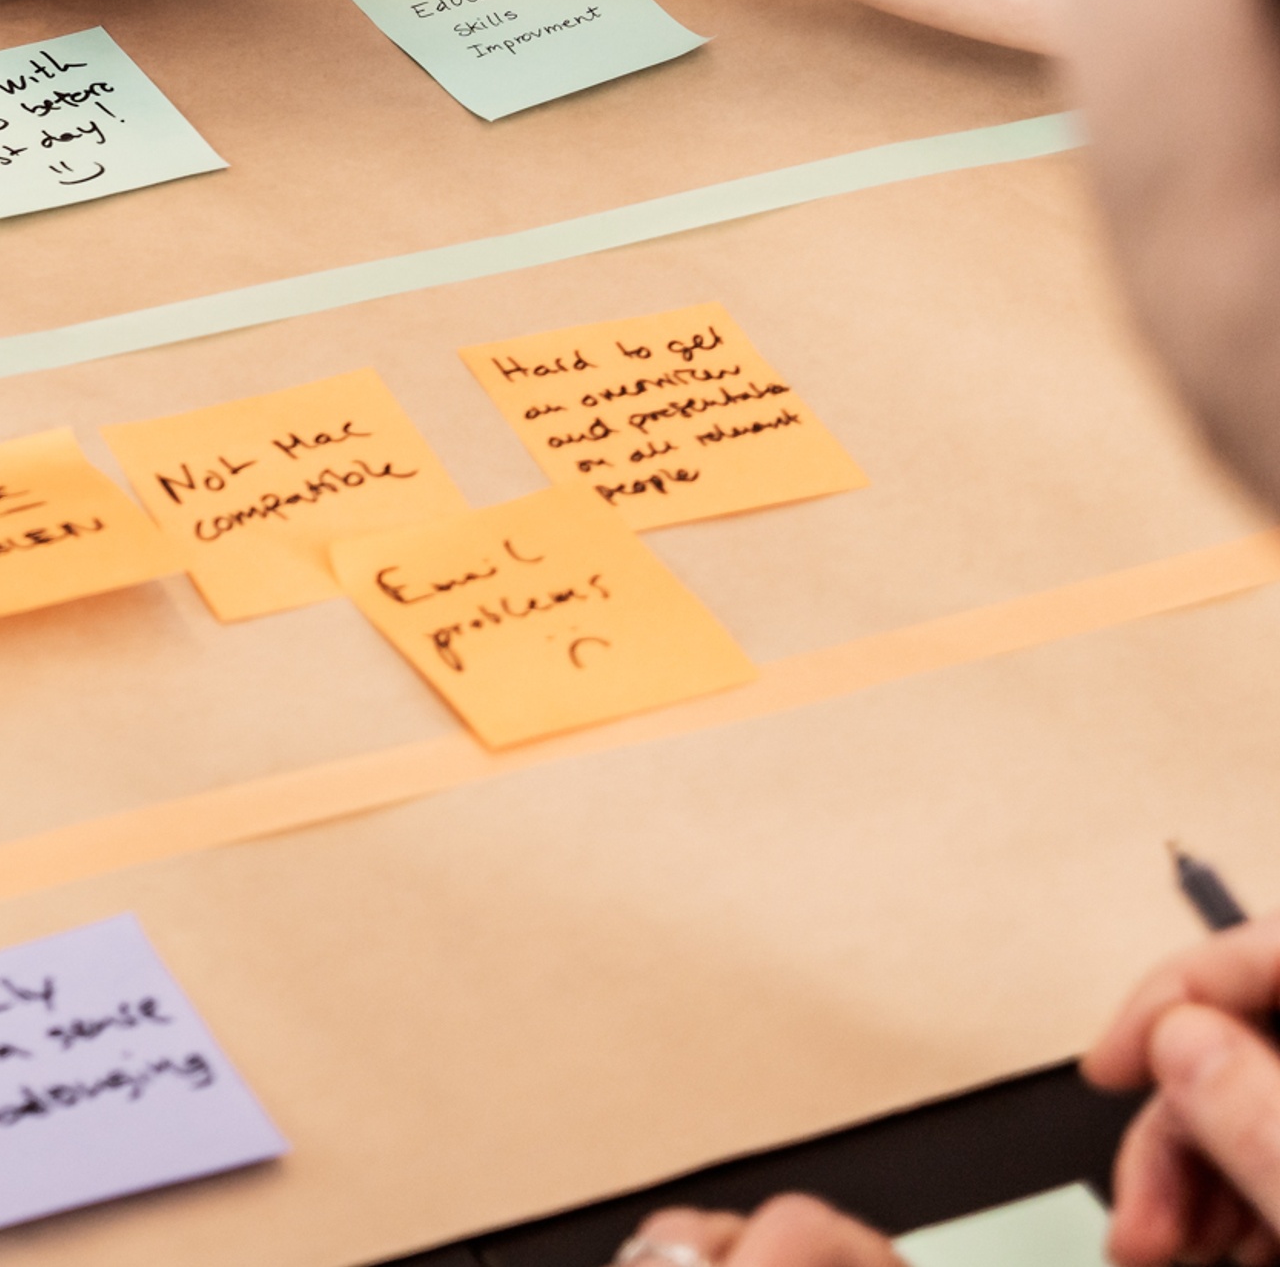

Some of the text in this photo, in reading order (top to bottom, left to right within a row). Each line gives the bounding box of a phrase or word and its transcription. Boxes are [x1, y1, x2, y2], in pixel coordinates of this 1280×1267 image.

[492, 350, 597, 382] Hard
[616, 341, 652, 360] to
[156, 456, 259, 505] Not
